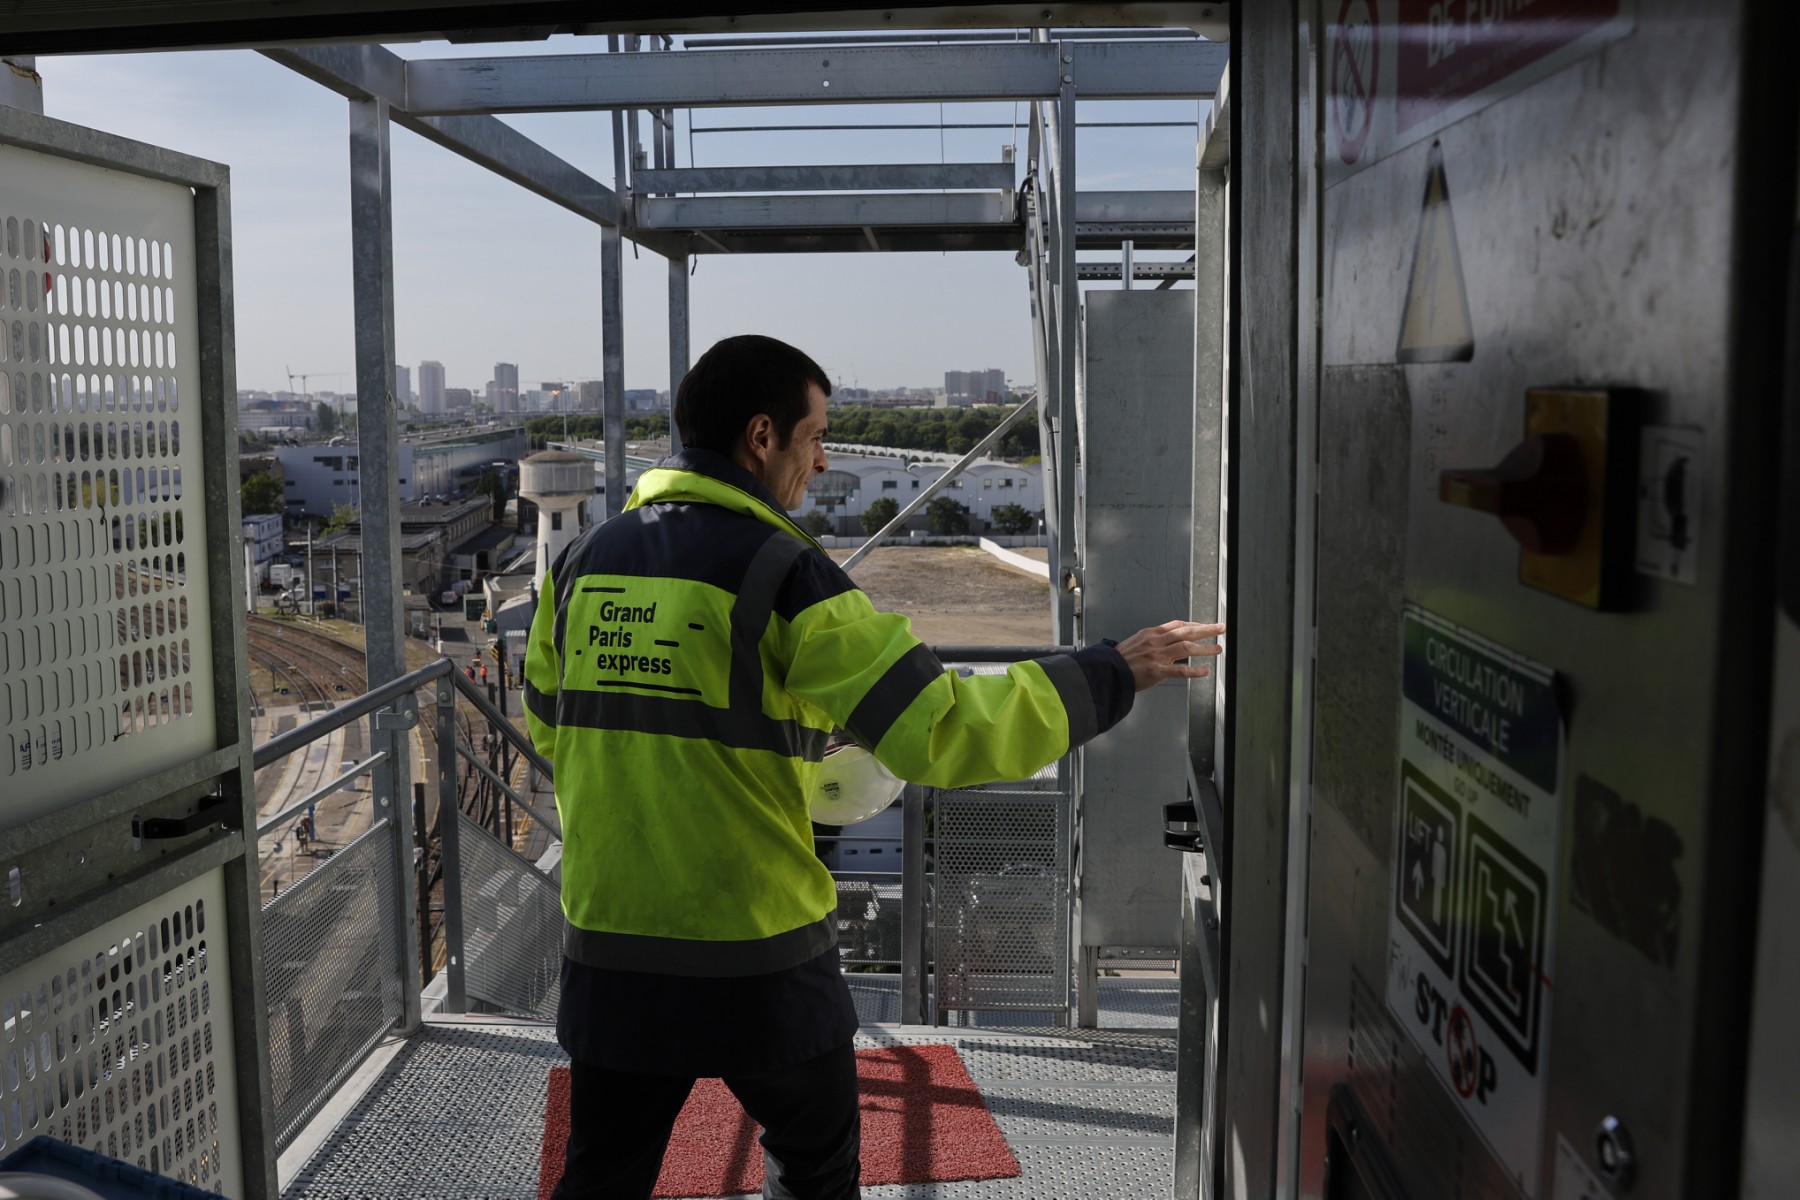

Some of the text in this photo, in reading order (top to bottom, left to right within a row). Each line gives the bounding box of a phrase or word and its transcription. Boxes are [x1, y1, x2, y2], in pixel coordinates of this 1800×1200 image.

[600, 601, 657, 623] Grand
[589, 625, 633, 648] Paris
[597, 653, 672, 676] express
[1425, 636, 1524, 717] CIRCULATION
[1433, 678, 1511, 754] VERTICALE
[1456, 748, 1531, 819] UNIQUEMENT
[1408, 810, 1432, 853] LIFT
